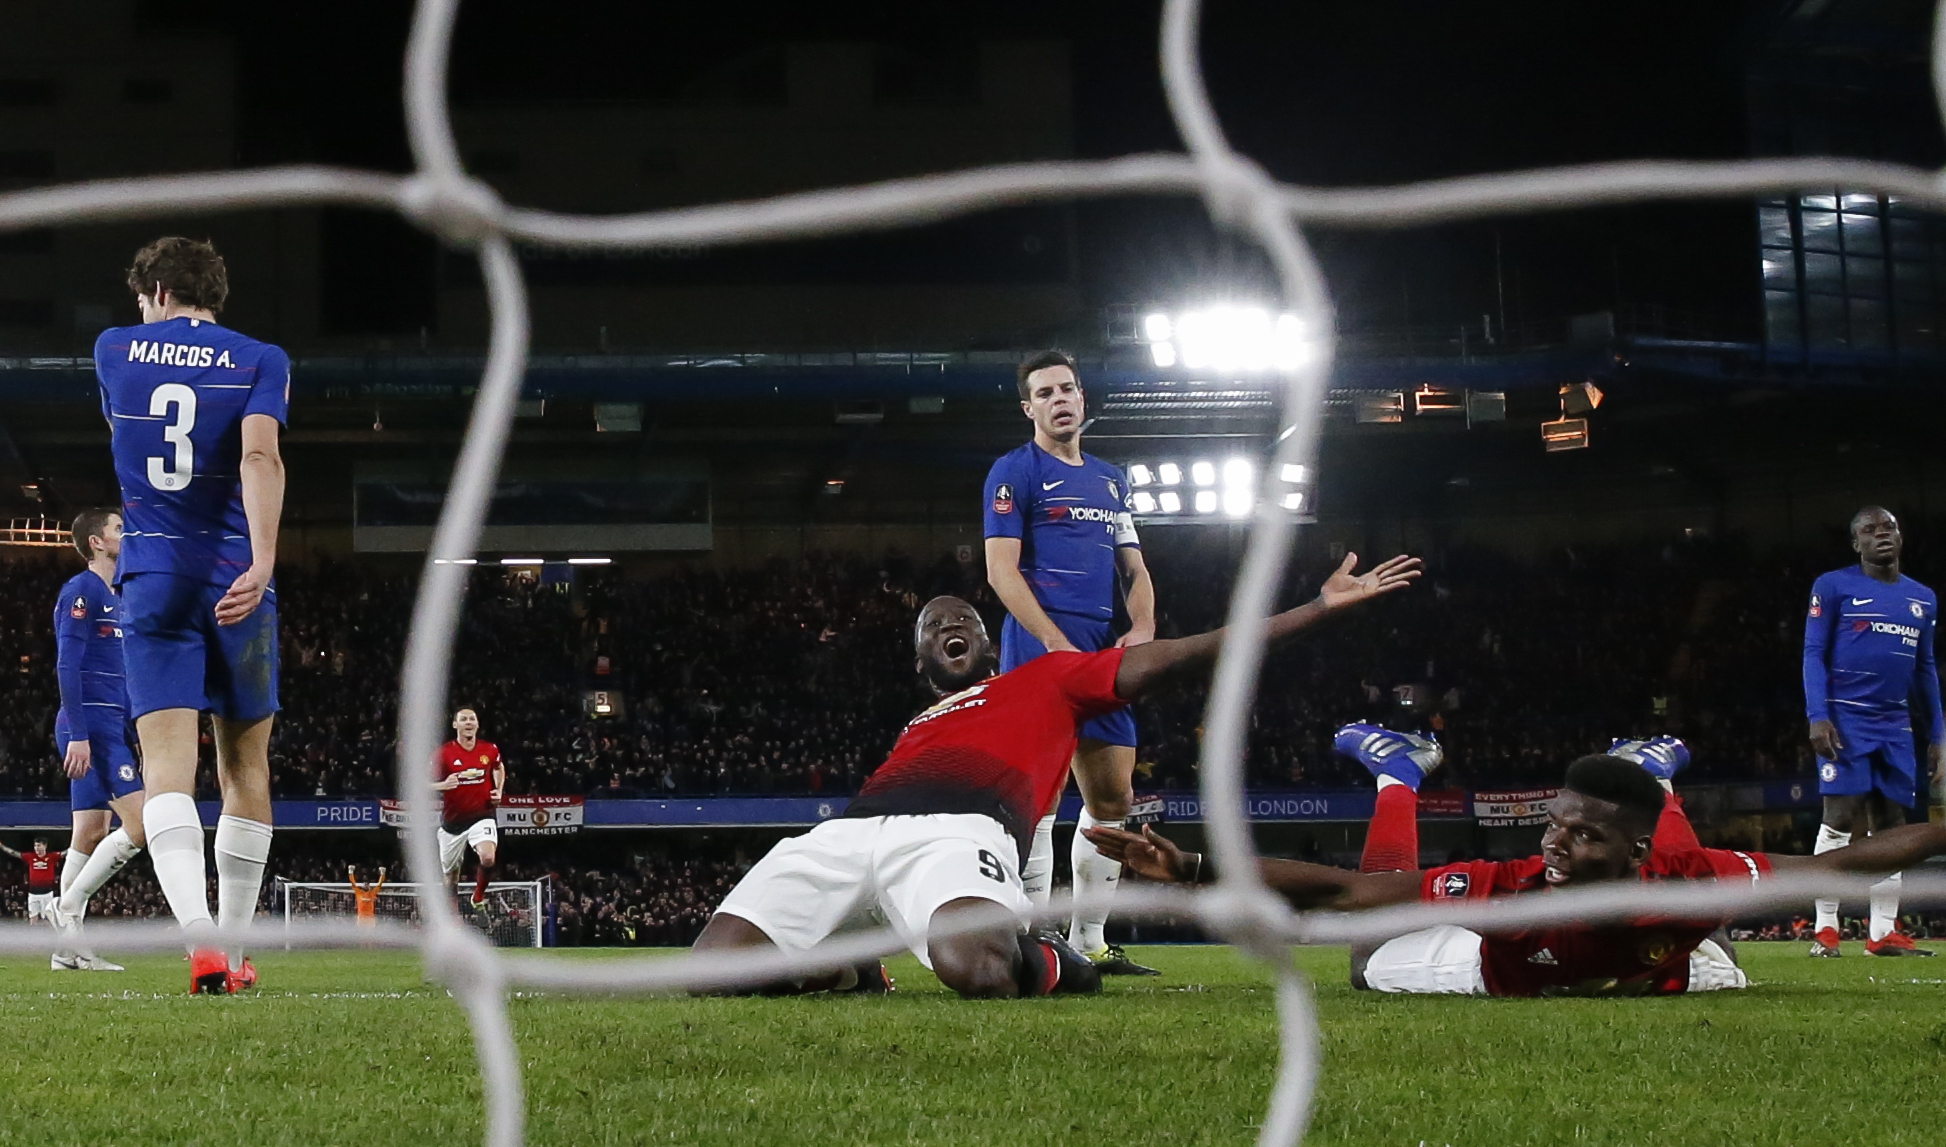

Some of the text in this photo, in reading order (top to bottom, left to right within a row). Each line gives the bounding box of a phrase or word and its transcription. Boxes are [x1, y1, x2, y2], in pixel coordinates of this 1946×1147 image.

[128, 340, 236, 369] MARCOS A.
[147, 383, 196, 491] 3
[596, 693, 606, 706] 5
[538, 796, 571, 804] LOVE
[1475, 789, 1544, 801] EVERYTHING
[317, 806, 373, 821] PRIDE
[1248, 800, 1329, 815] LONDON
[507, 812, 572, 822] MU FC
[504, 826, 578, 836] MANCHESTER
[978, 849, 1006, 883] 9
